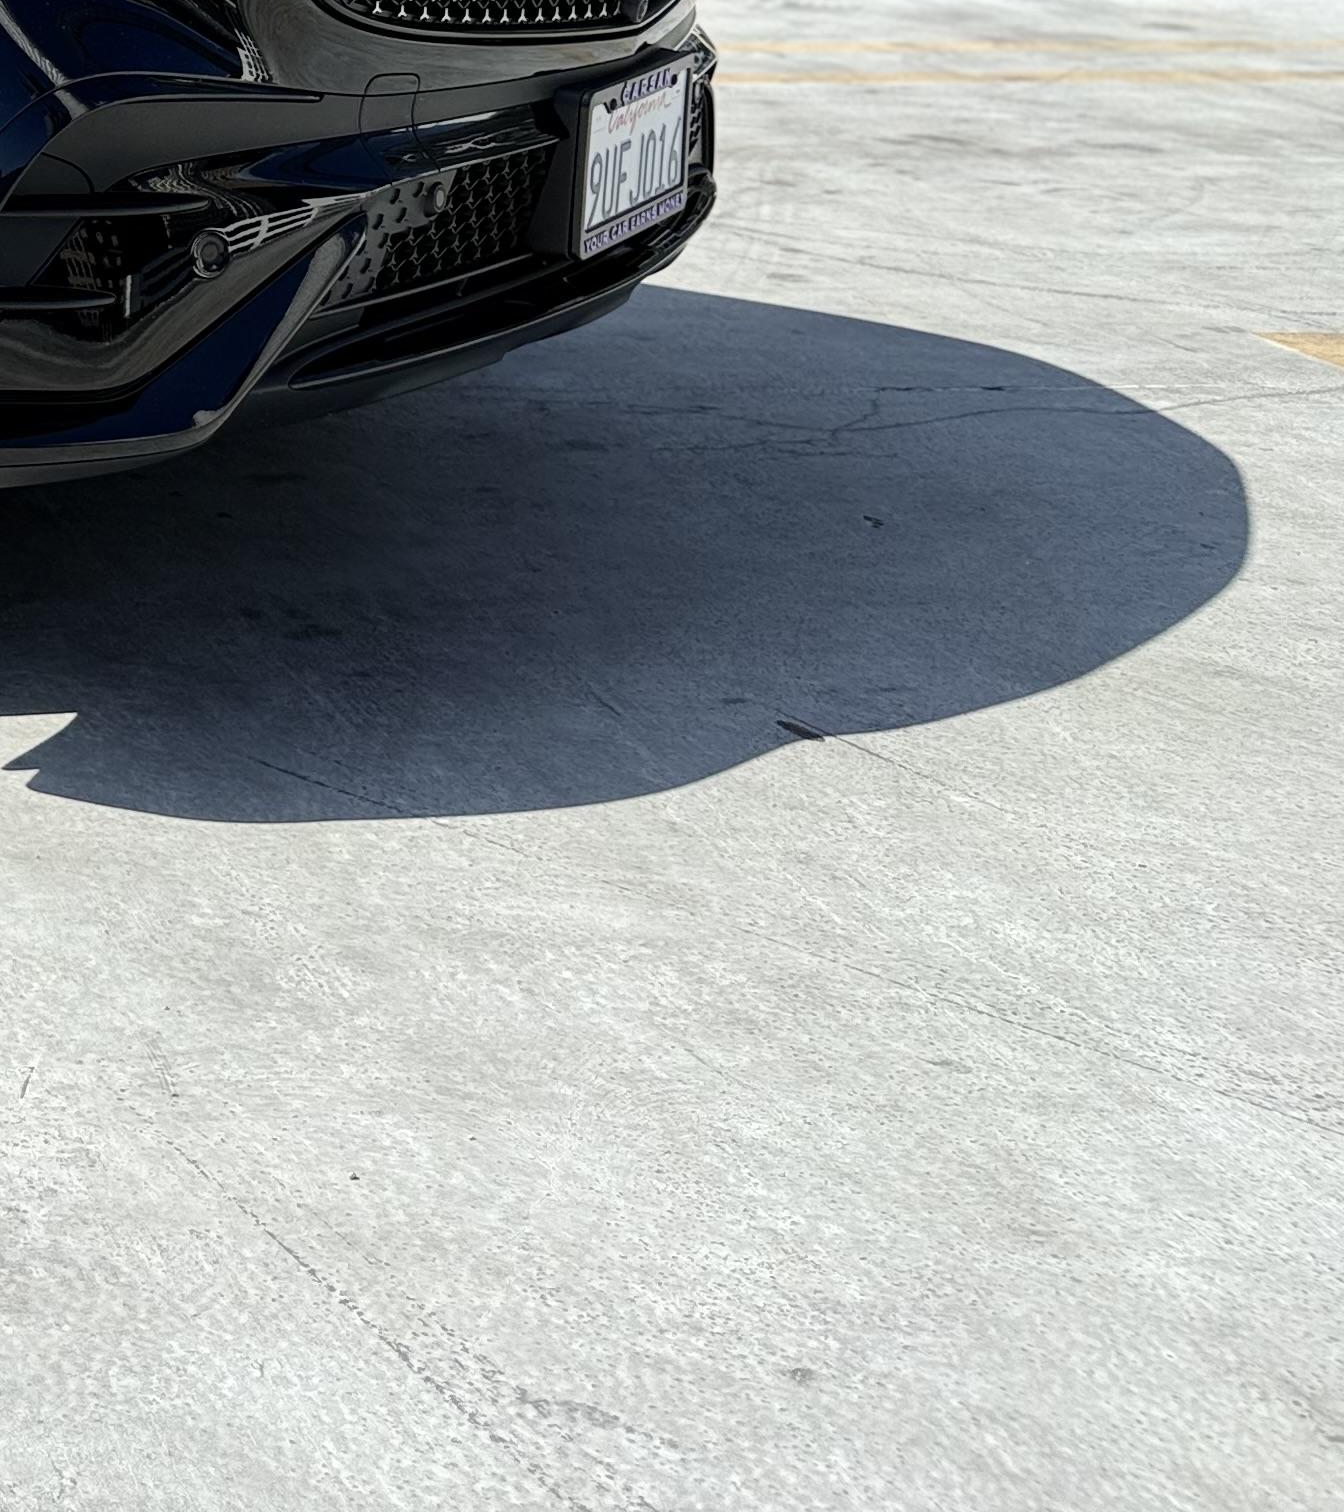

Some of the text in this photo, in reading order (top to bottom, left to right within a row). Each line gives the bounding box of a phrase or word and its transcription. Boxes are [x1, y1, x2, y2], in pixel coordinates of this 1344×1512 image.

[586, 116, 682, 230] 9UFJ016
[584, 190, 684, 253] YOUR CAR EARNS MONEY
